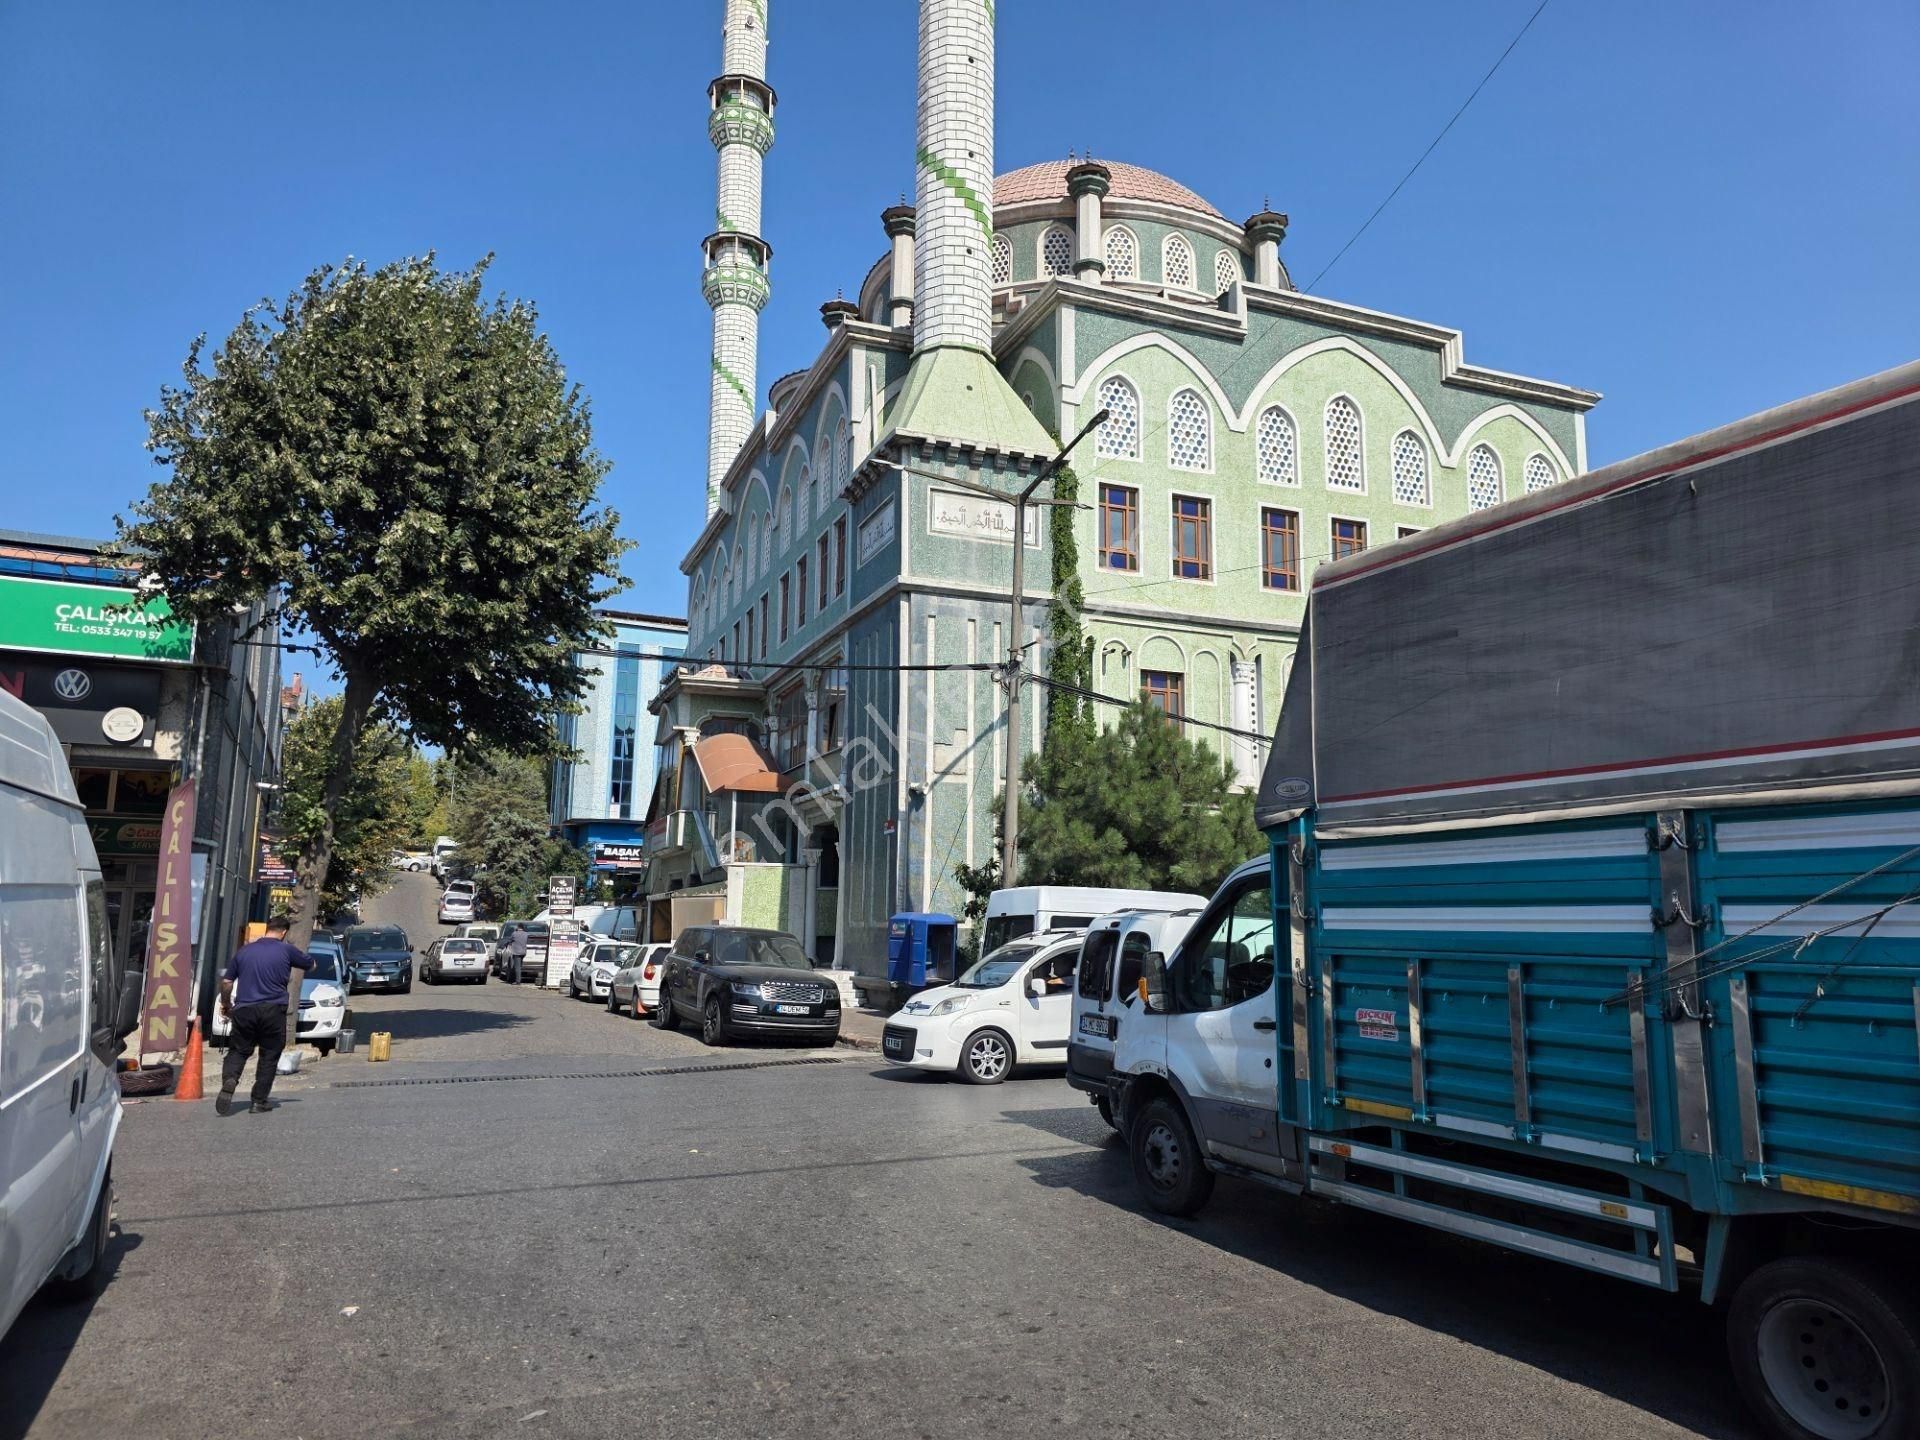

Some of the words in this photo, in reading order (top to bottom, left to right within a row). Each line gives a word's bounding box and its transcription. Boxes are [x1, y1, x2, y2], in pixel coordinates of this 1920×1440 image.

[56, 604, 164, 626] ÇALIŞKAN
[54, 622, 79, 633] TEL:
[82, 625, 111, 636] 0533
[113, 628, 133, 637] 347
[135, 630, 147, 639] 19
[604, 848, 641, 857] BAŞAK
[149, 800, 186, 1041] ÇALIŞKAN
